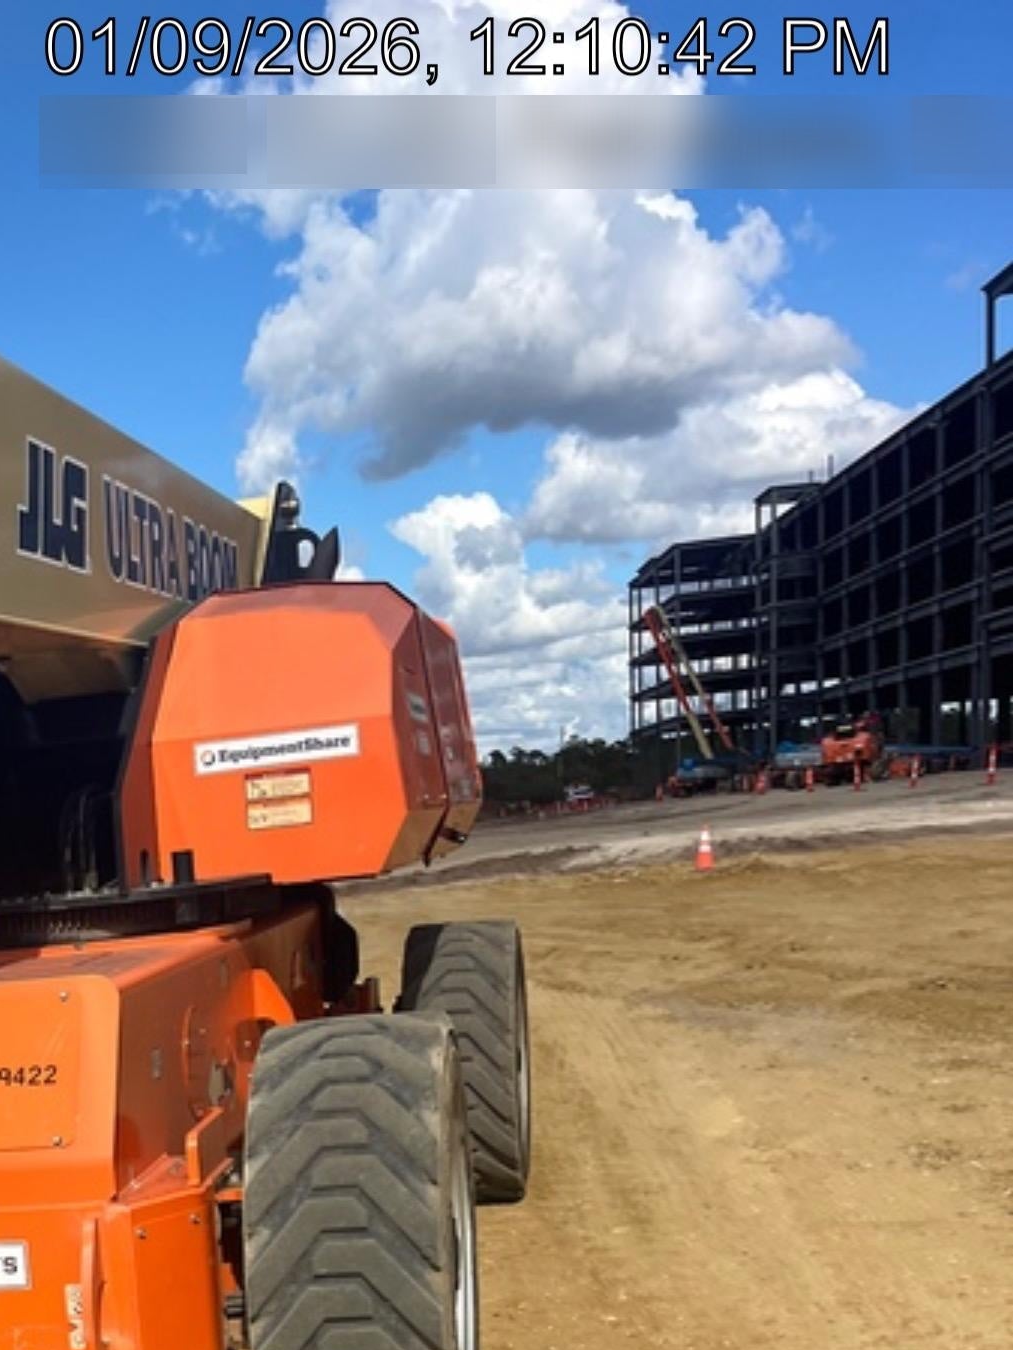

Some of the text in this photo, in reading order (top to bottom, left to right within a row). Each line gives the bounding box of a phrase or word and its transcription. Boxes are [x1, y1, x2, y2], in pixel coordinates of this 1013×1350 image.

[18, 436, 89, 574] JLG
[104, 476, 183, 600] ULTRA
[218, 735, 352, 763] EquipmentShare
